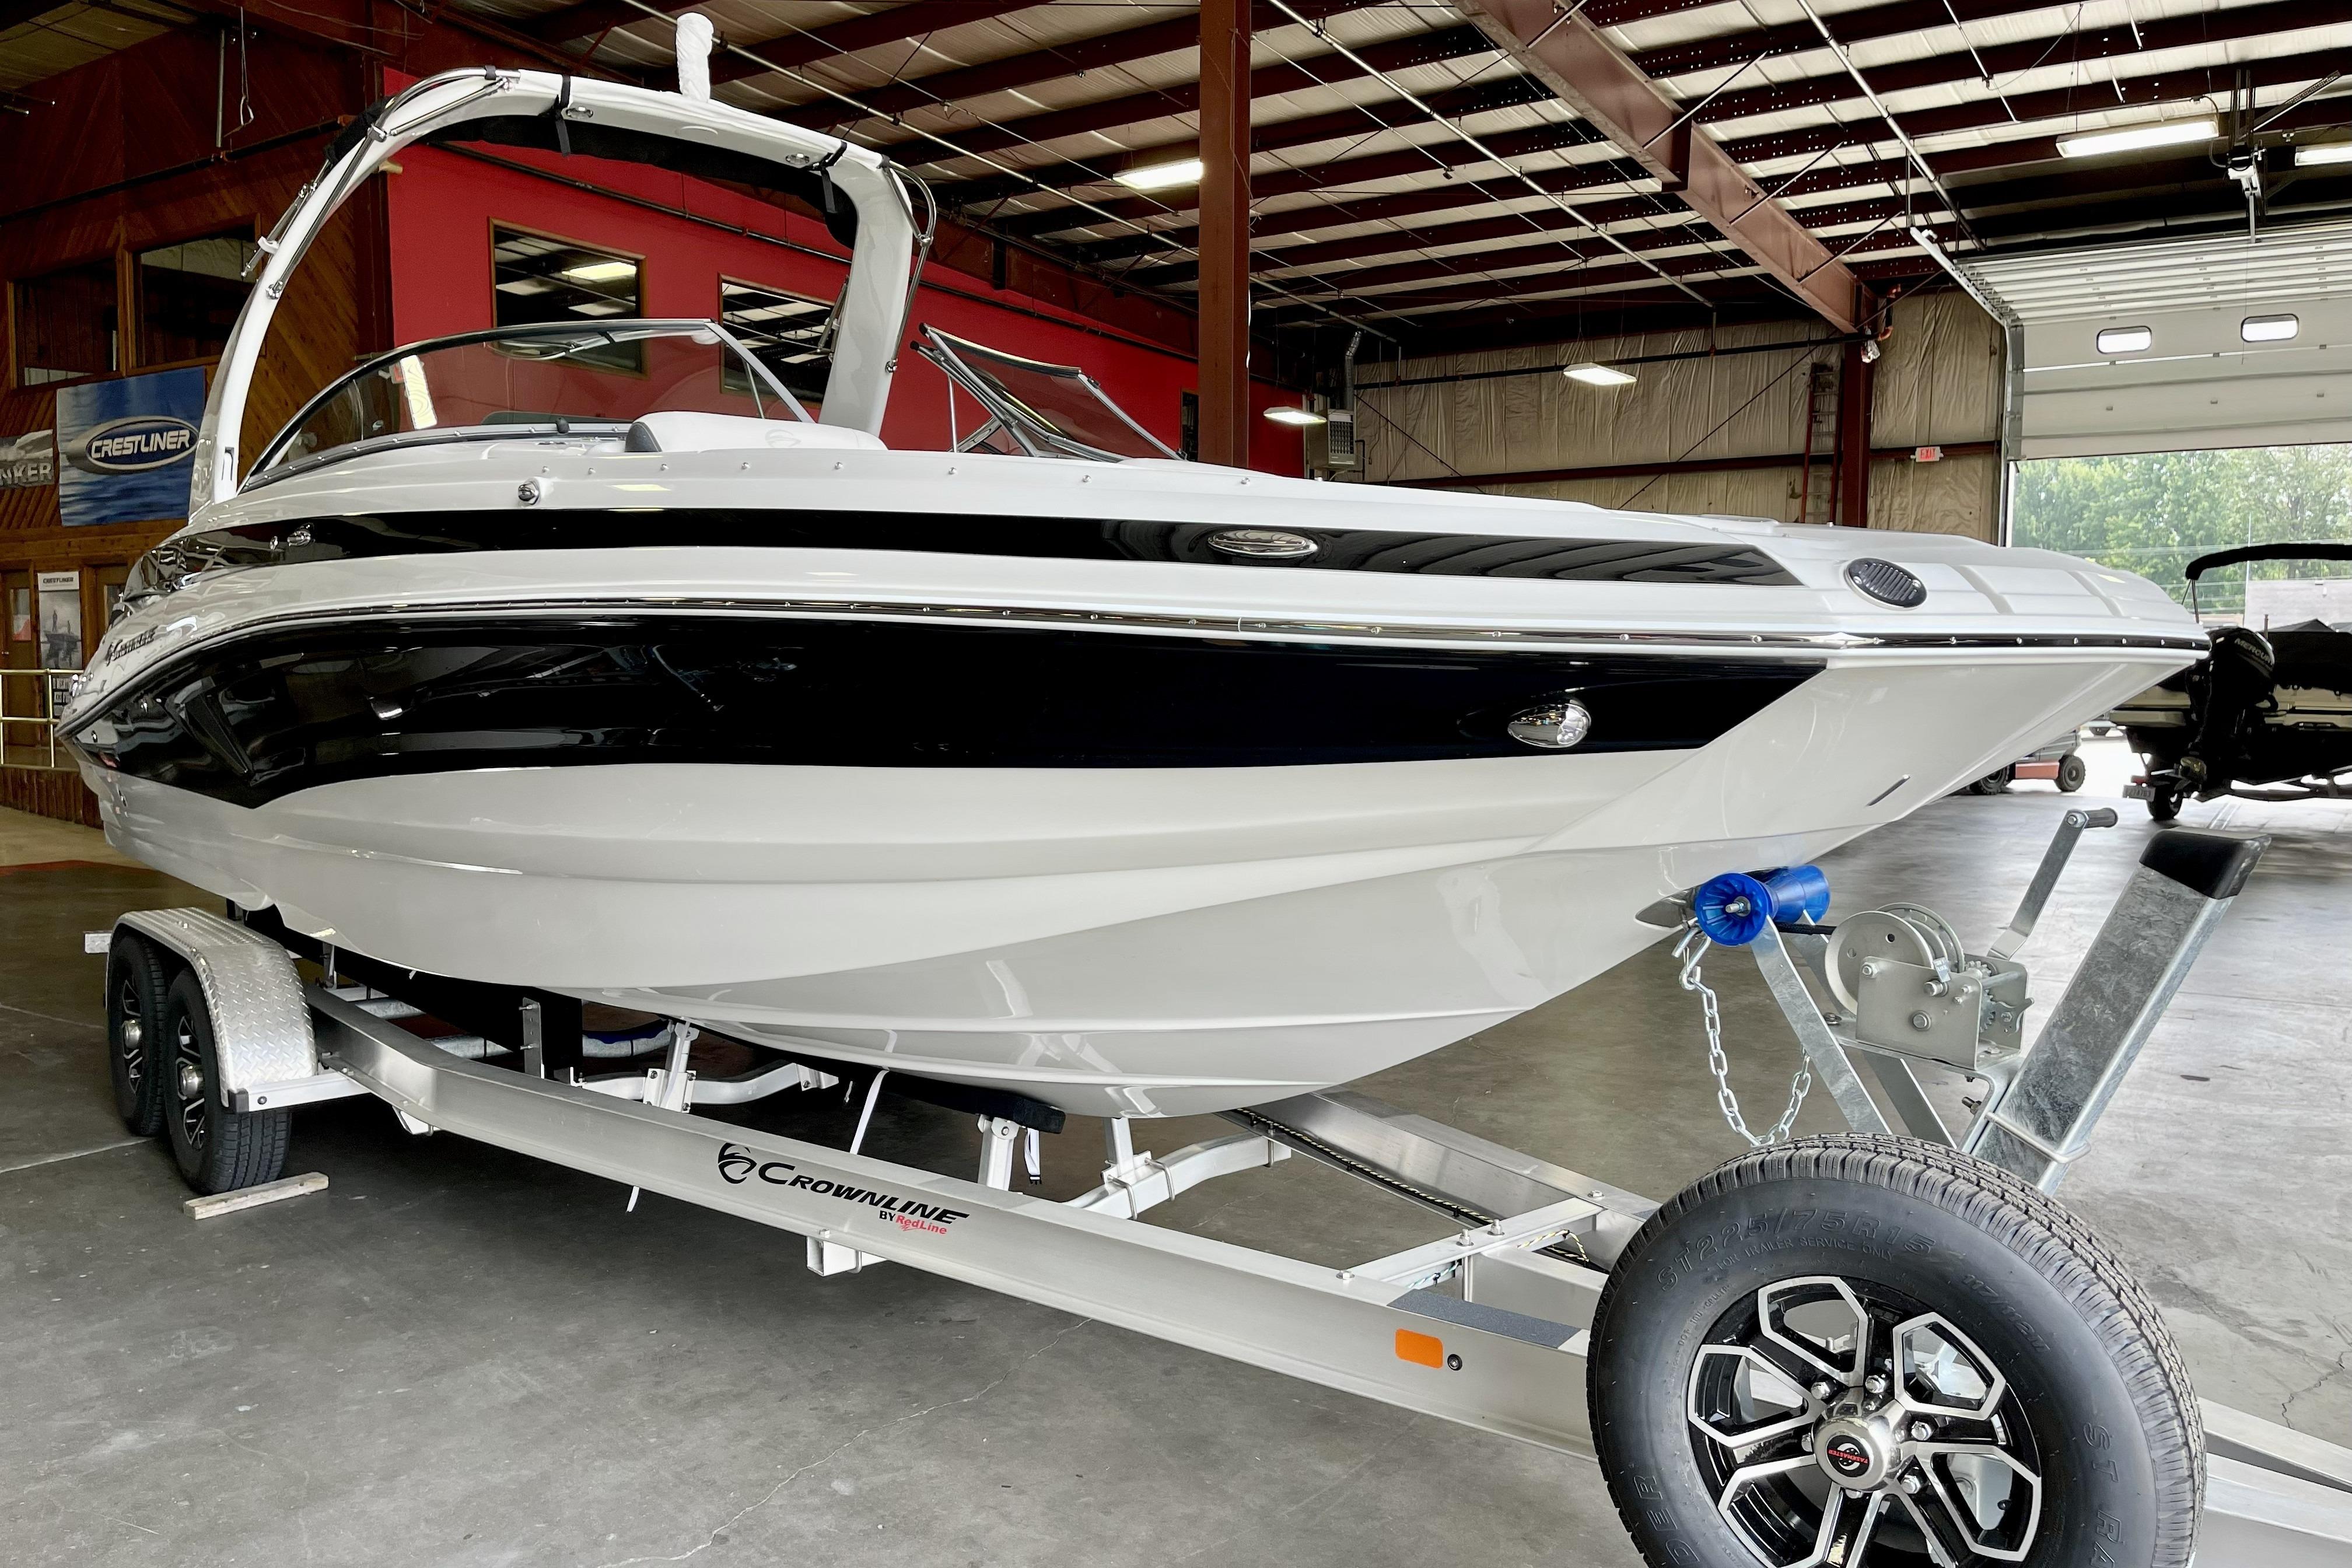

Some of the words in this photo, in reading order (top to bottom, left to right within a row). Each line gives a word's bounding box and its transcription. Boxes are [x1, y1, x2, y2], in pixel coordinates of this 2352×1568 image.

[91, 429, 190, 459] CRESTLINER
[1920, 448, 1936, 459] EXIT
[2234, 638, 2273, 666] MERCUR
[758, 1161, 970, 1224] CROWNLINE
[879, 1210, 897, 1222] BY
[897, 1214, 947, 1234] RedLine
[1745, 1238, 1793, 1257] TRAILER
[1799, 1236, 1856, 1252] SERVICE
[1863, 1242, 1896, 1262] ONLY
[1828, 1449, 1868, 1464] TASKMASTER
[2083, 1423, 2119, 1483] ST
